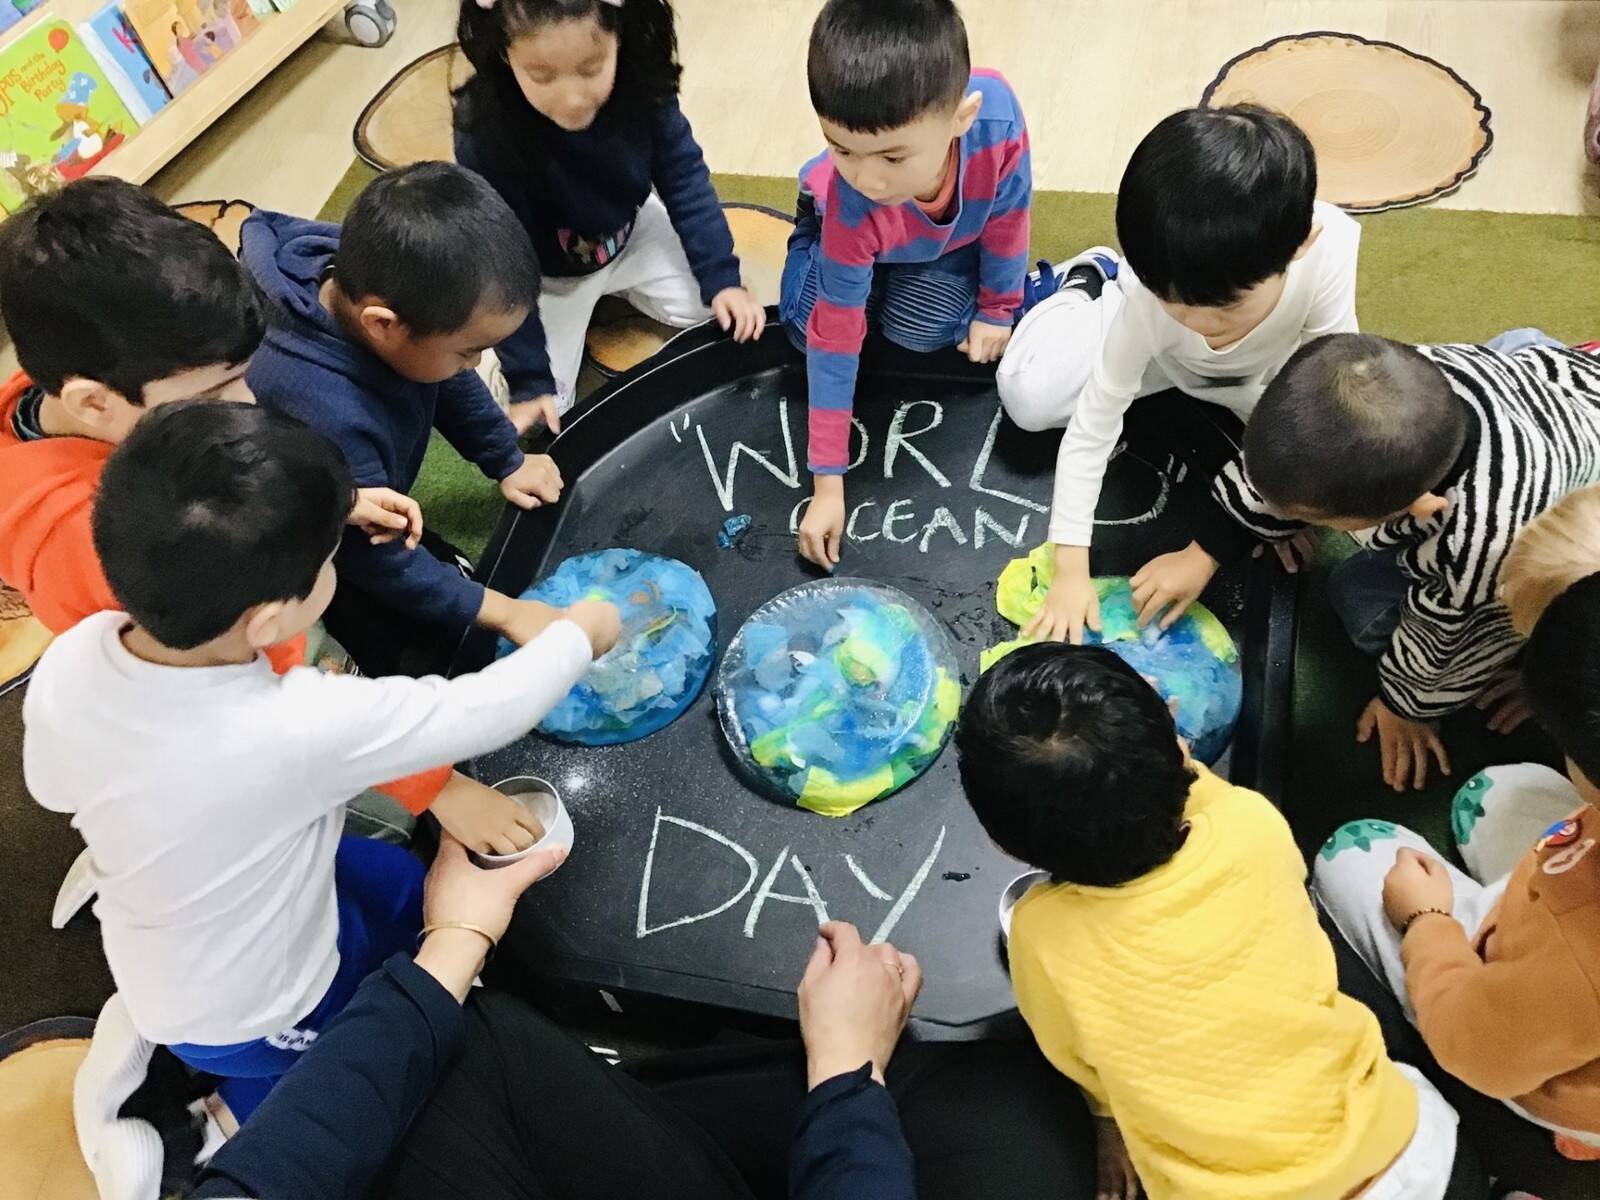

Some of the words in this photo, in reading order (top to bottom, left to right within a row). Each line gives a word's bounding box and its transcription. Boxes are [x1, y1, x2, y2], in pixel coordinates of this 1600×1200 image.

[20, 59, 66, 93] Birthday
[34, 77, 66, 102] Party
[635, 806, 946, 945] DAY
